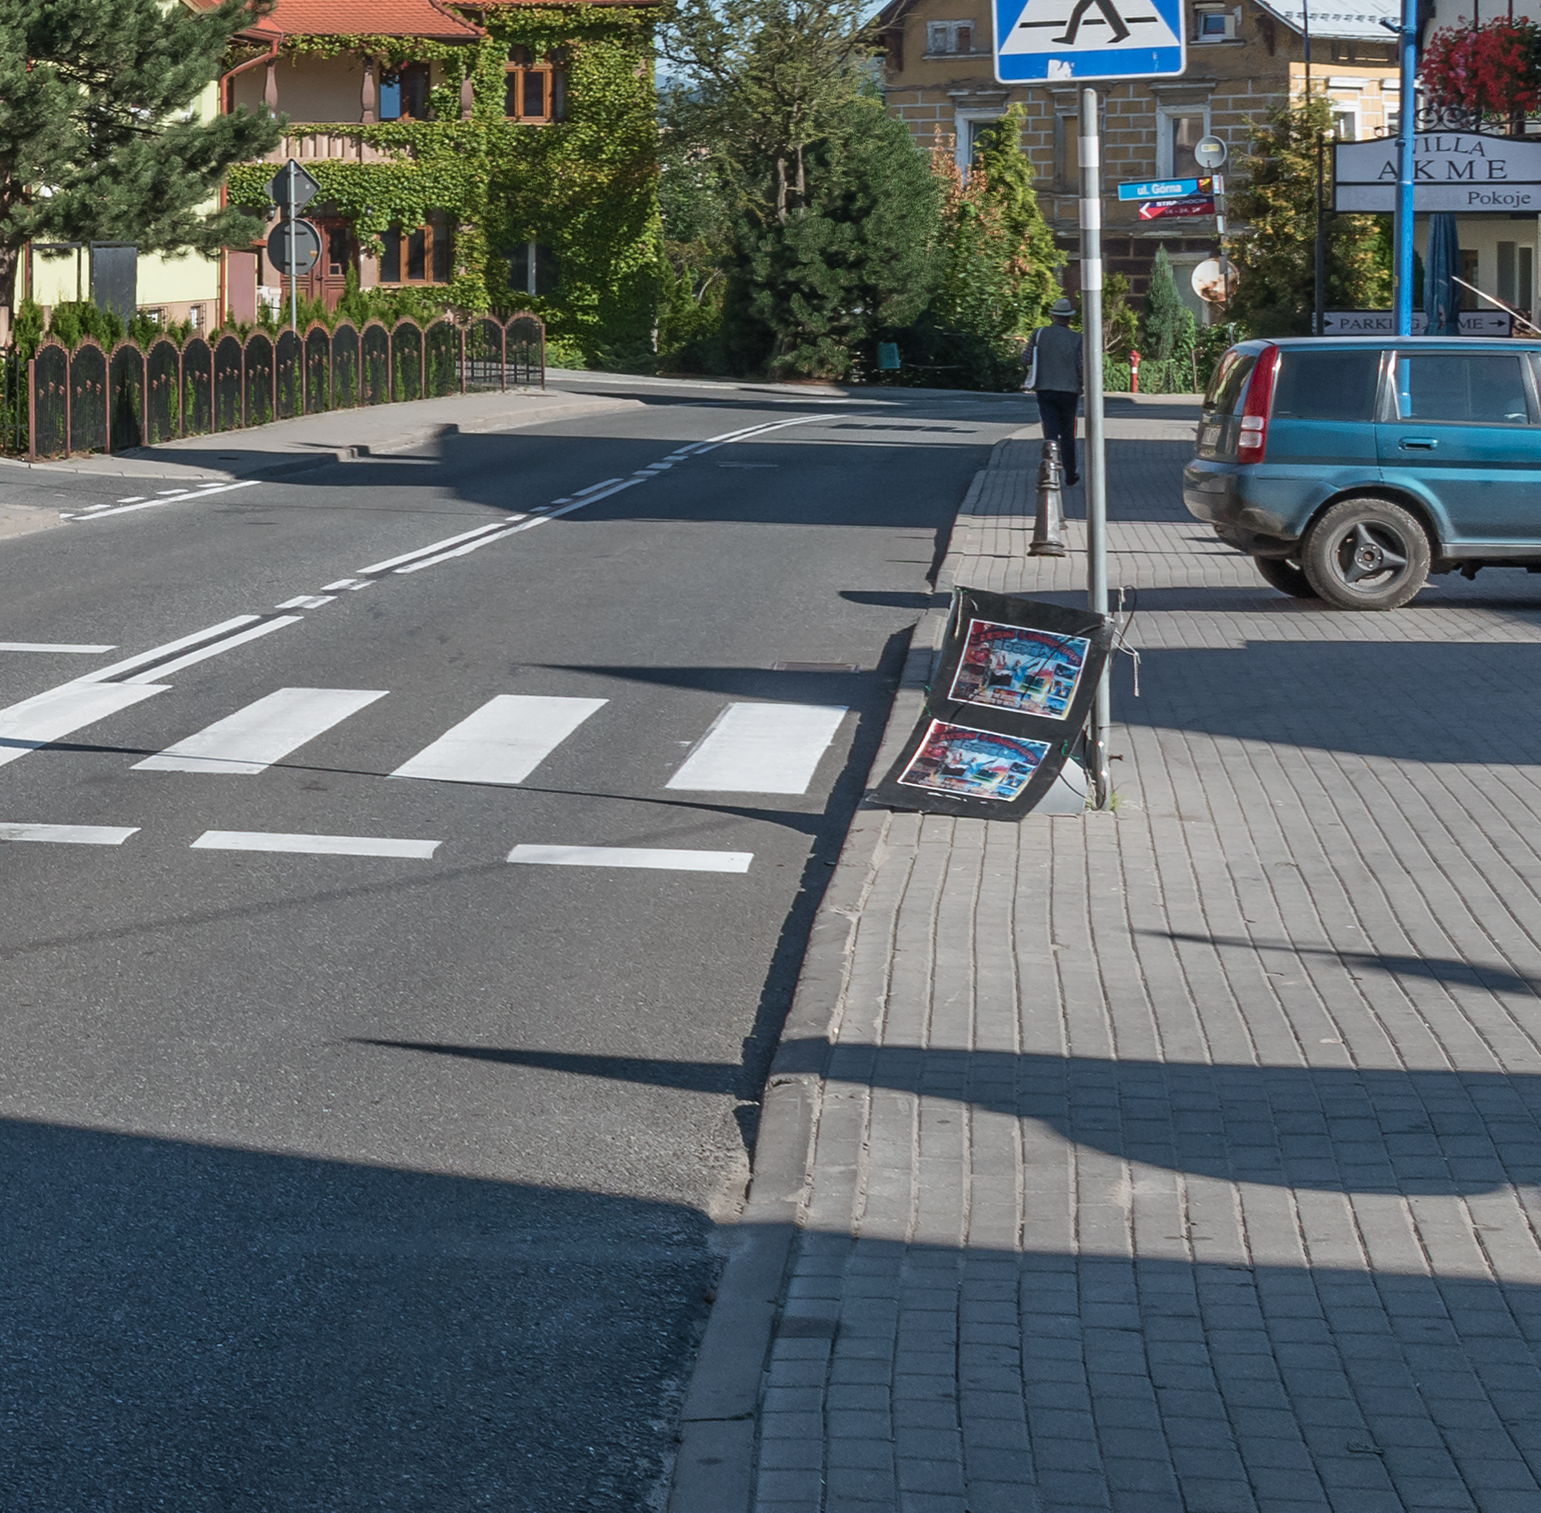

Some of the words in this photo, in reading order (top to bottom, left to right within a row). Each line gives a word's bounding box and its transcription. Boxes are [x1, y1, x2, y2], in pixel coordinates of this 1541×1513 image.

[1413, 136, 1486, 157] ILLA
[1377, 159, 1508, 180] AKME
[1467, 191, 1532, 208] Pokoje
[1340, 318, 1420, 330] PARKIG
